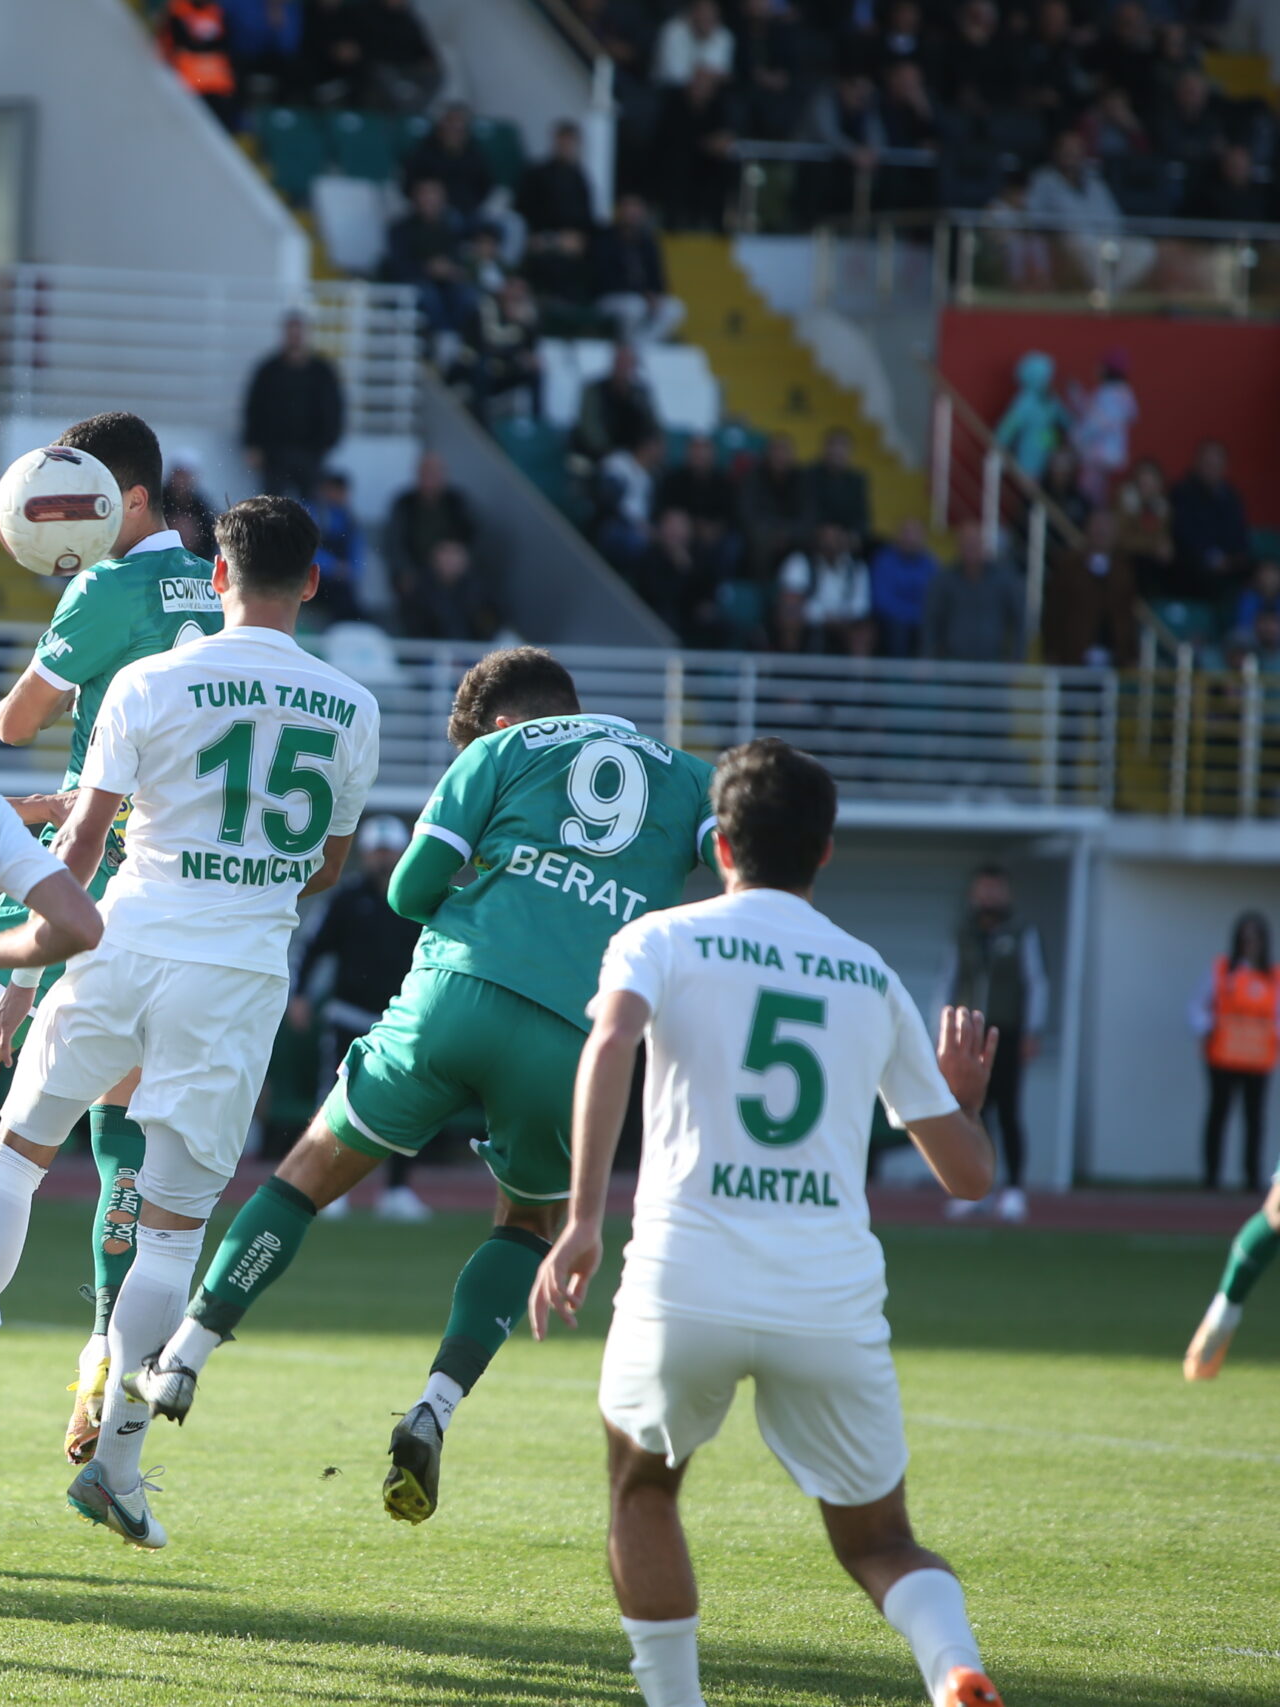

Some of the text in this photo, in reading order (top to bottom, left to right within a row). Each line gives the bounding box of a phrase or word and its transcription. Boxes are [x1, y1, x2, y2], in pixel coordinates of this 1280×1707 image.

[187, 681, 357, 729] TUNA TARIM
[196, 720, 339, 856] 15
[560, 737, 649, 858] 9
[505, 845, 647, 922] BERAT
[695, 936, 890, 998] TUNA TARIM
[735, 985, 828, 1148] 5
[710, 1162, 840, 1208] KARTAL
